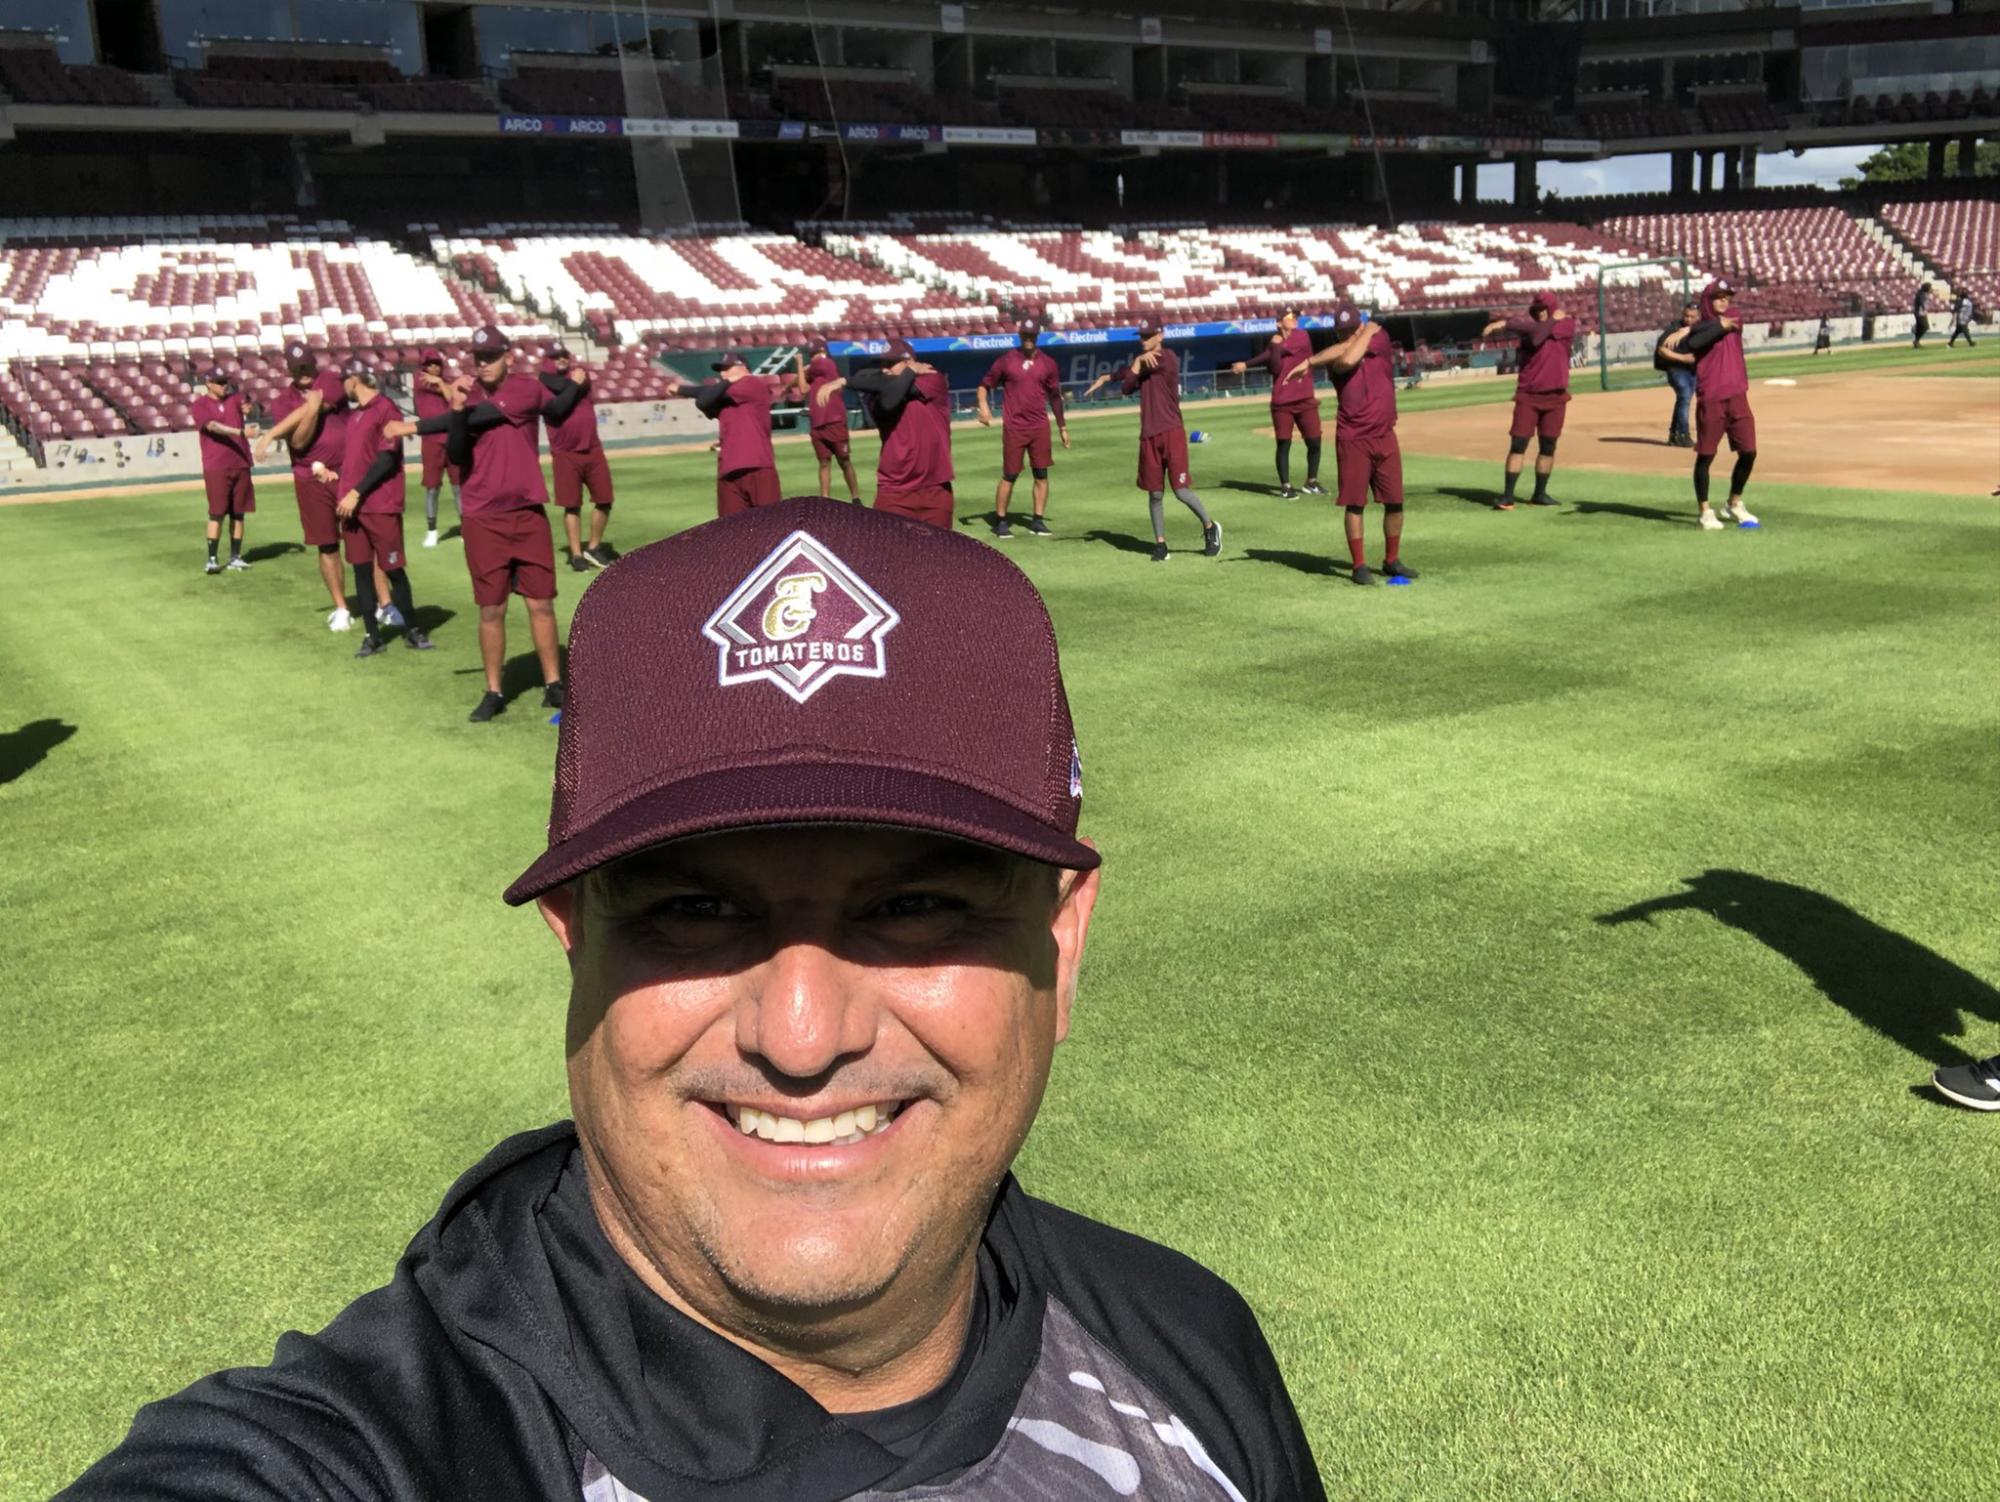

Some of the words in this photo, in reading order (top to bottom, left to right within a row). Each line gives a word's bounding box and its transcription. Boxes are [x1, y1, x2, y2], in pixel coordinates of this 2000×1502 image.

[504, 118, 543, 132] ARCO
[569, 119, 607, 133] ARCO
[847, 125, 880, 139] ARCO
[899, 125, 930, 140] ARCO
[735, 641, 866, 669] TOMATEROS
